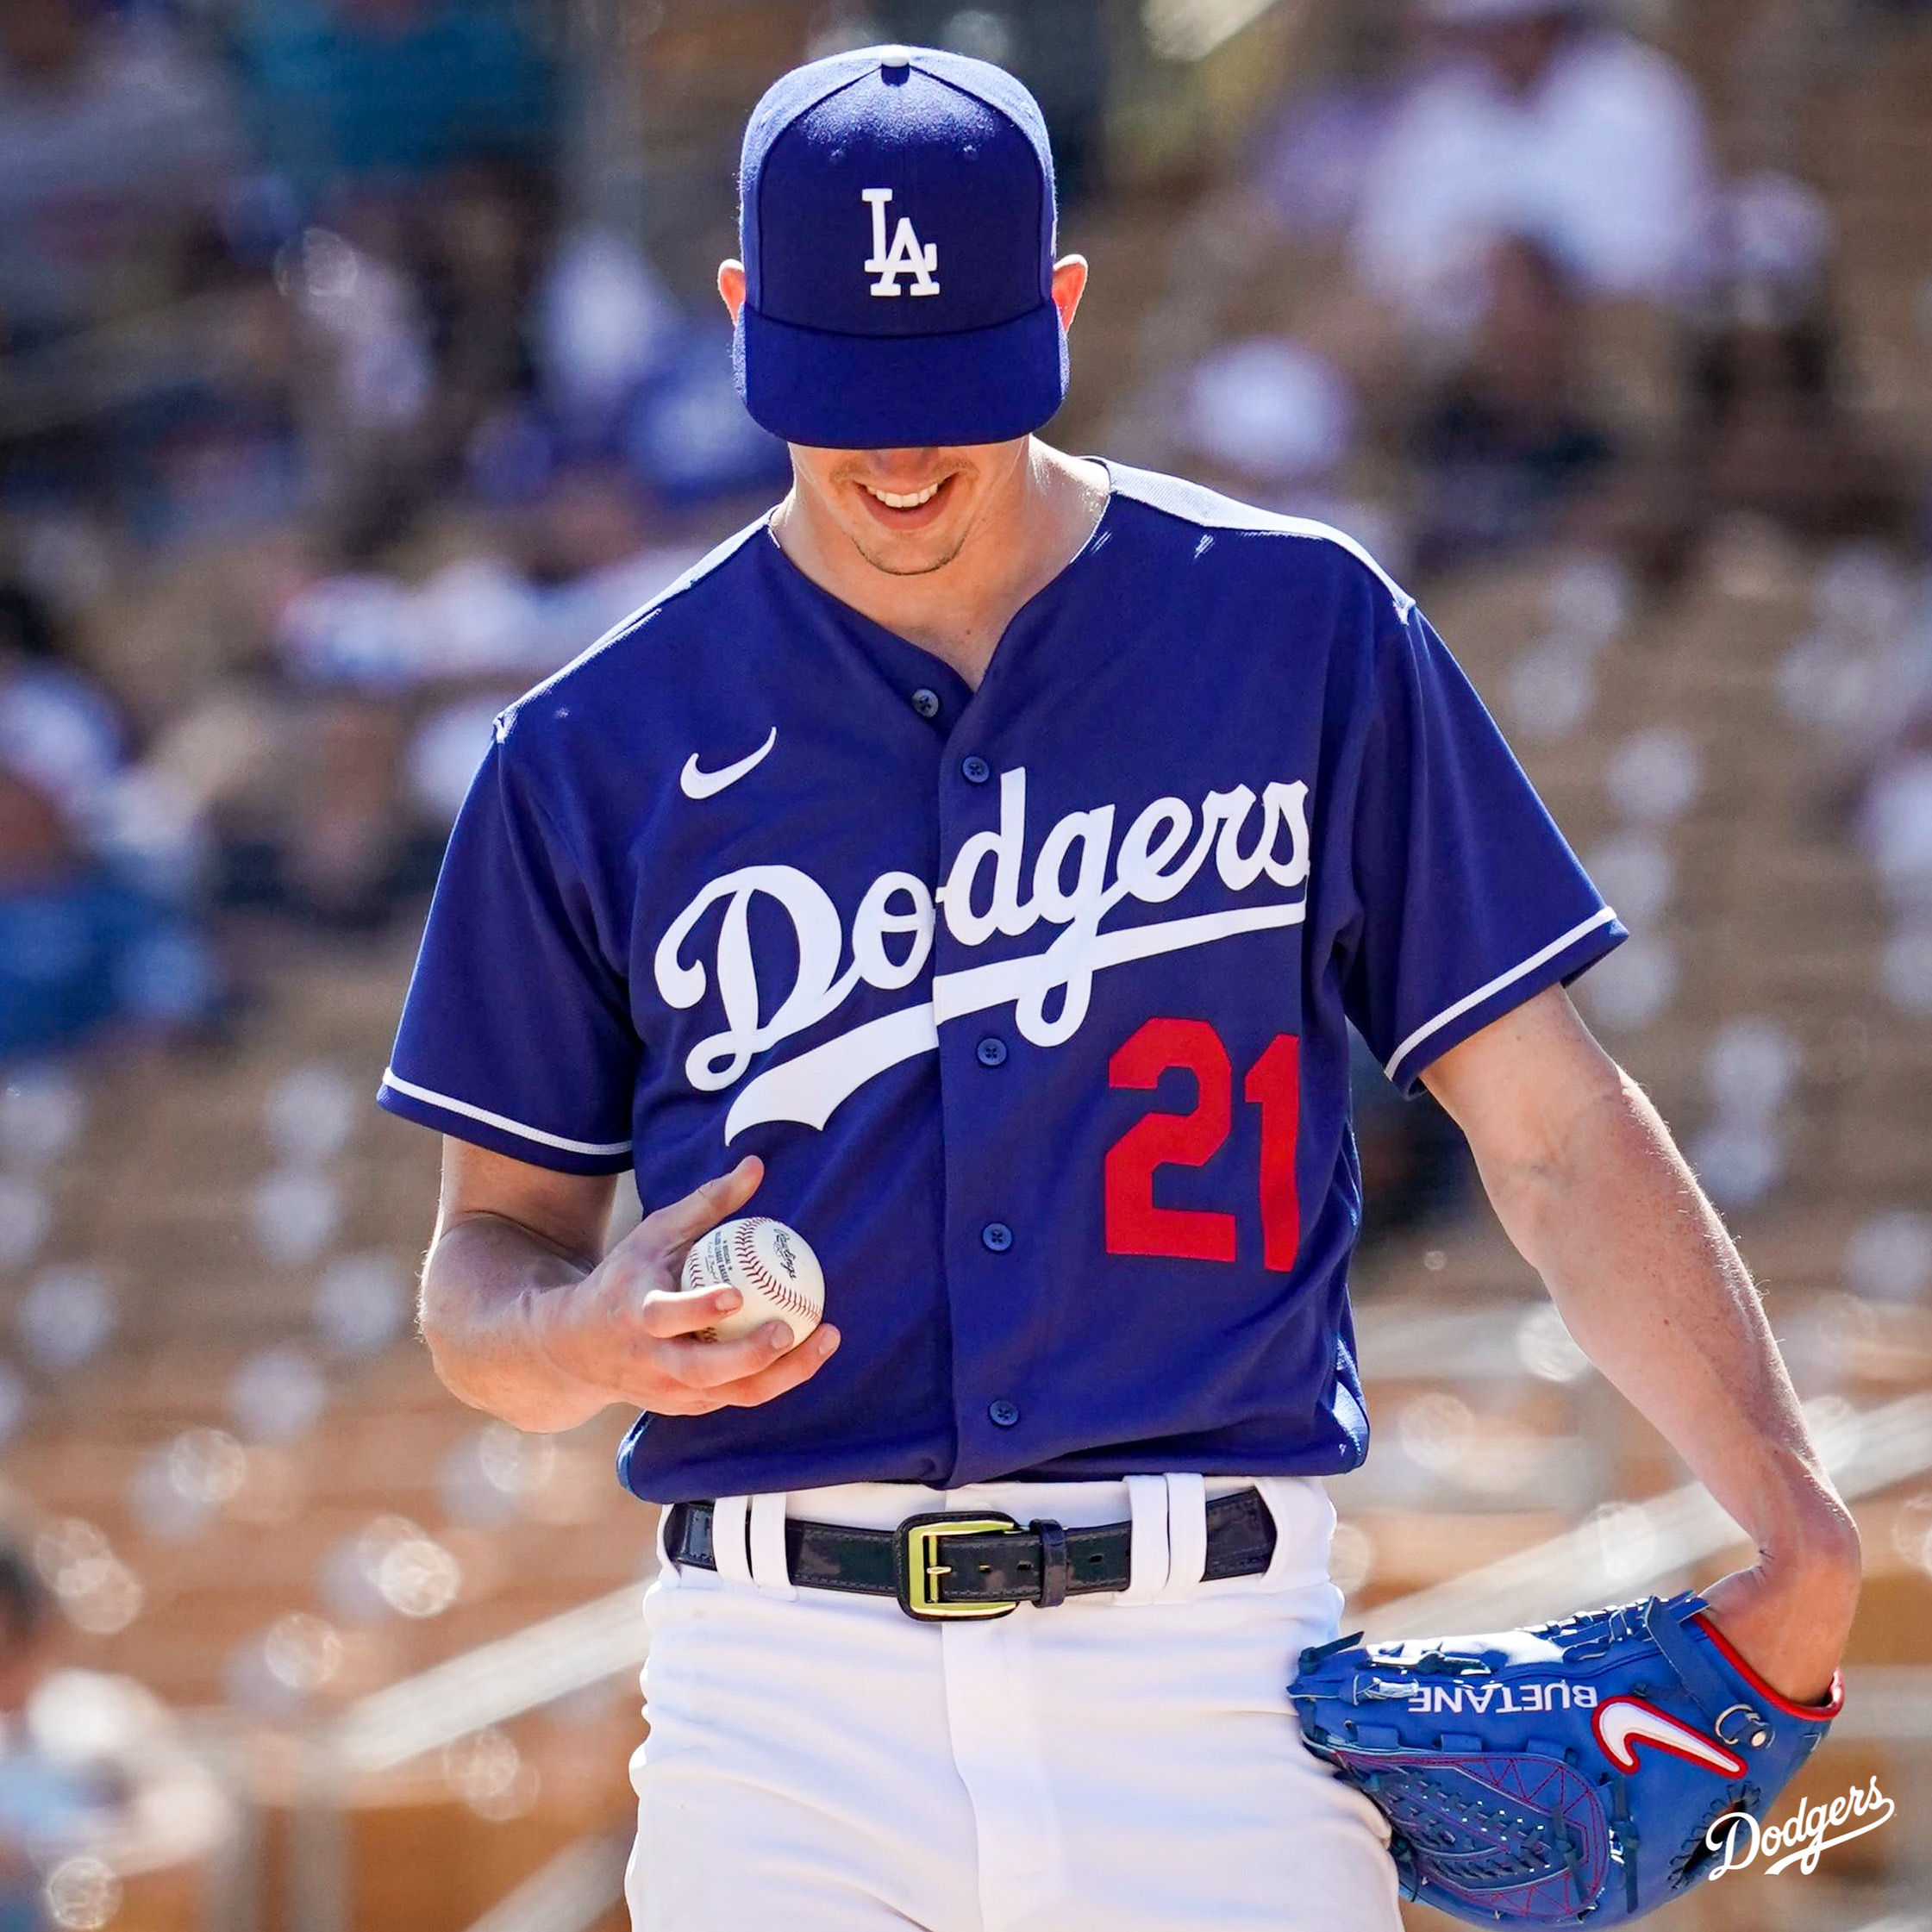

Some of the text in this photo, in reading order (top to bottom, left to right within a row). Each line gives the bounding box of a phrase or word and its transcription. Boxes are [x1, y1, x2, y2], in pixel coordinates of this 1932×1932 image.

[862, 189, 940, 297] LA
[654, 767, 1310, 1092] Dodgers
[1105, 1018, 1299, 1271] 21
[1408, 1683, 1598, 1714] BUETANE
